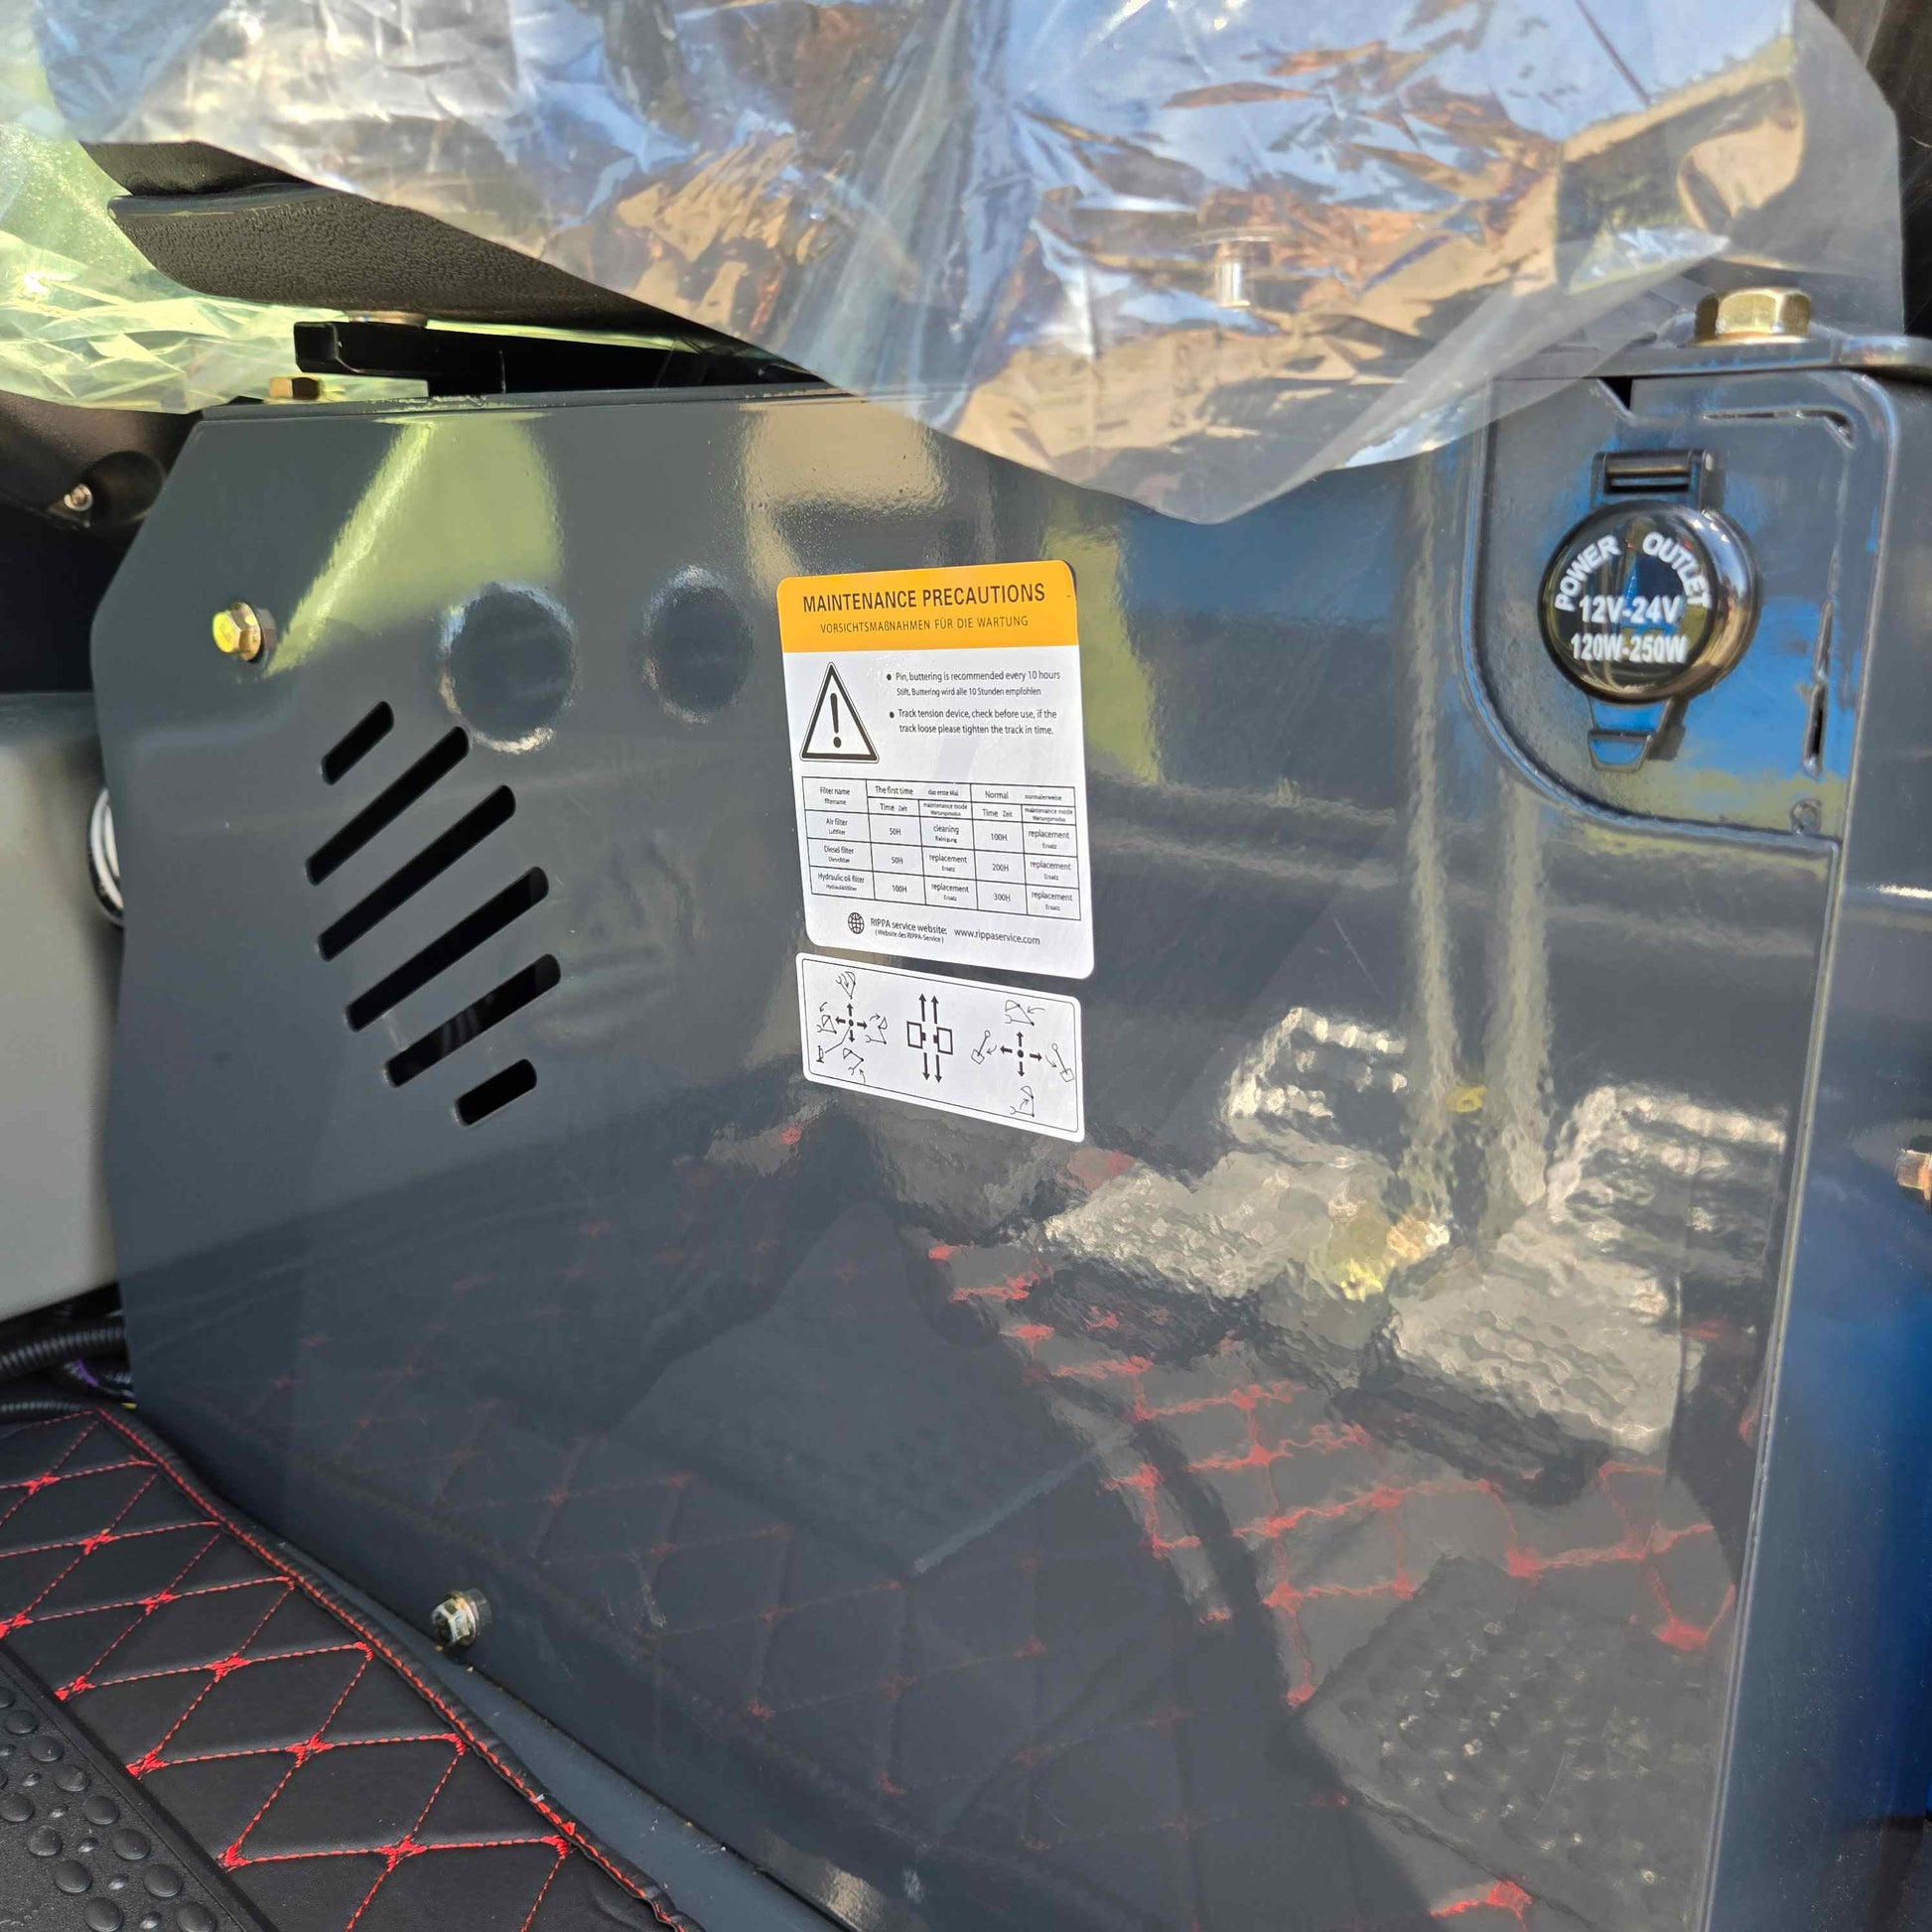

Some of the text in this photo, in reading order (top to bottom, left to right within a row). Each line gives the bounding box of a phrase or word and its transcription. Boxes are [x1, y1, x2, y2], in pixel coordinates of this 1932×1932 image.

[1555, 532, 1712, 612] POWER OUTLET
[803, 583, 1044, 612] MAINTENANCE PRECAUTIONS
[1580, 595, 1684, 624] 12V-24V
[820, 616, 1029, 633] VORSICHTSMAßNAHMEN FÜR DIE WARTUNG
[1571, 633, 1689, 663] 120W-250W
[909, 672, 942, 682] buttering
[951, 671, 1004, 680] recommended
[1006, 672, 1026, 681] every
[912, 688, 939, 697] Buttering
[1006, 687, 1041, 697] empfohlen
[898, 709, 916, 718] Track
[945, 710, 970, 719] device,
[1044, 710, 1056, 719] the
[938, 725, 961, 734] please
[962, 726, 989, 735] tighten
[1035, 726, 1053, 735] time.
[985, 790, 1009, 799] Normal
[933, 825, 959, 835] cleaning
[1029, 830, 1070, 839] replacement
[929, 854, 967, 863] replacement
[1031, 861, 1071, 871] replacement
[818, 873, 843, 882] Hydraulic
[931, 884, 969, 893] replacement
[994, 893, 1011, 901] 300H
[1032, 892, 1072, 900] replacement
[871, 917, 1040, 945] RIPPA service website: www.rippaservice.com
